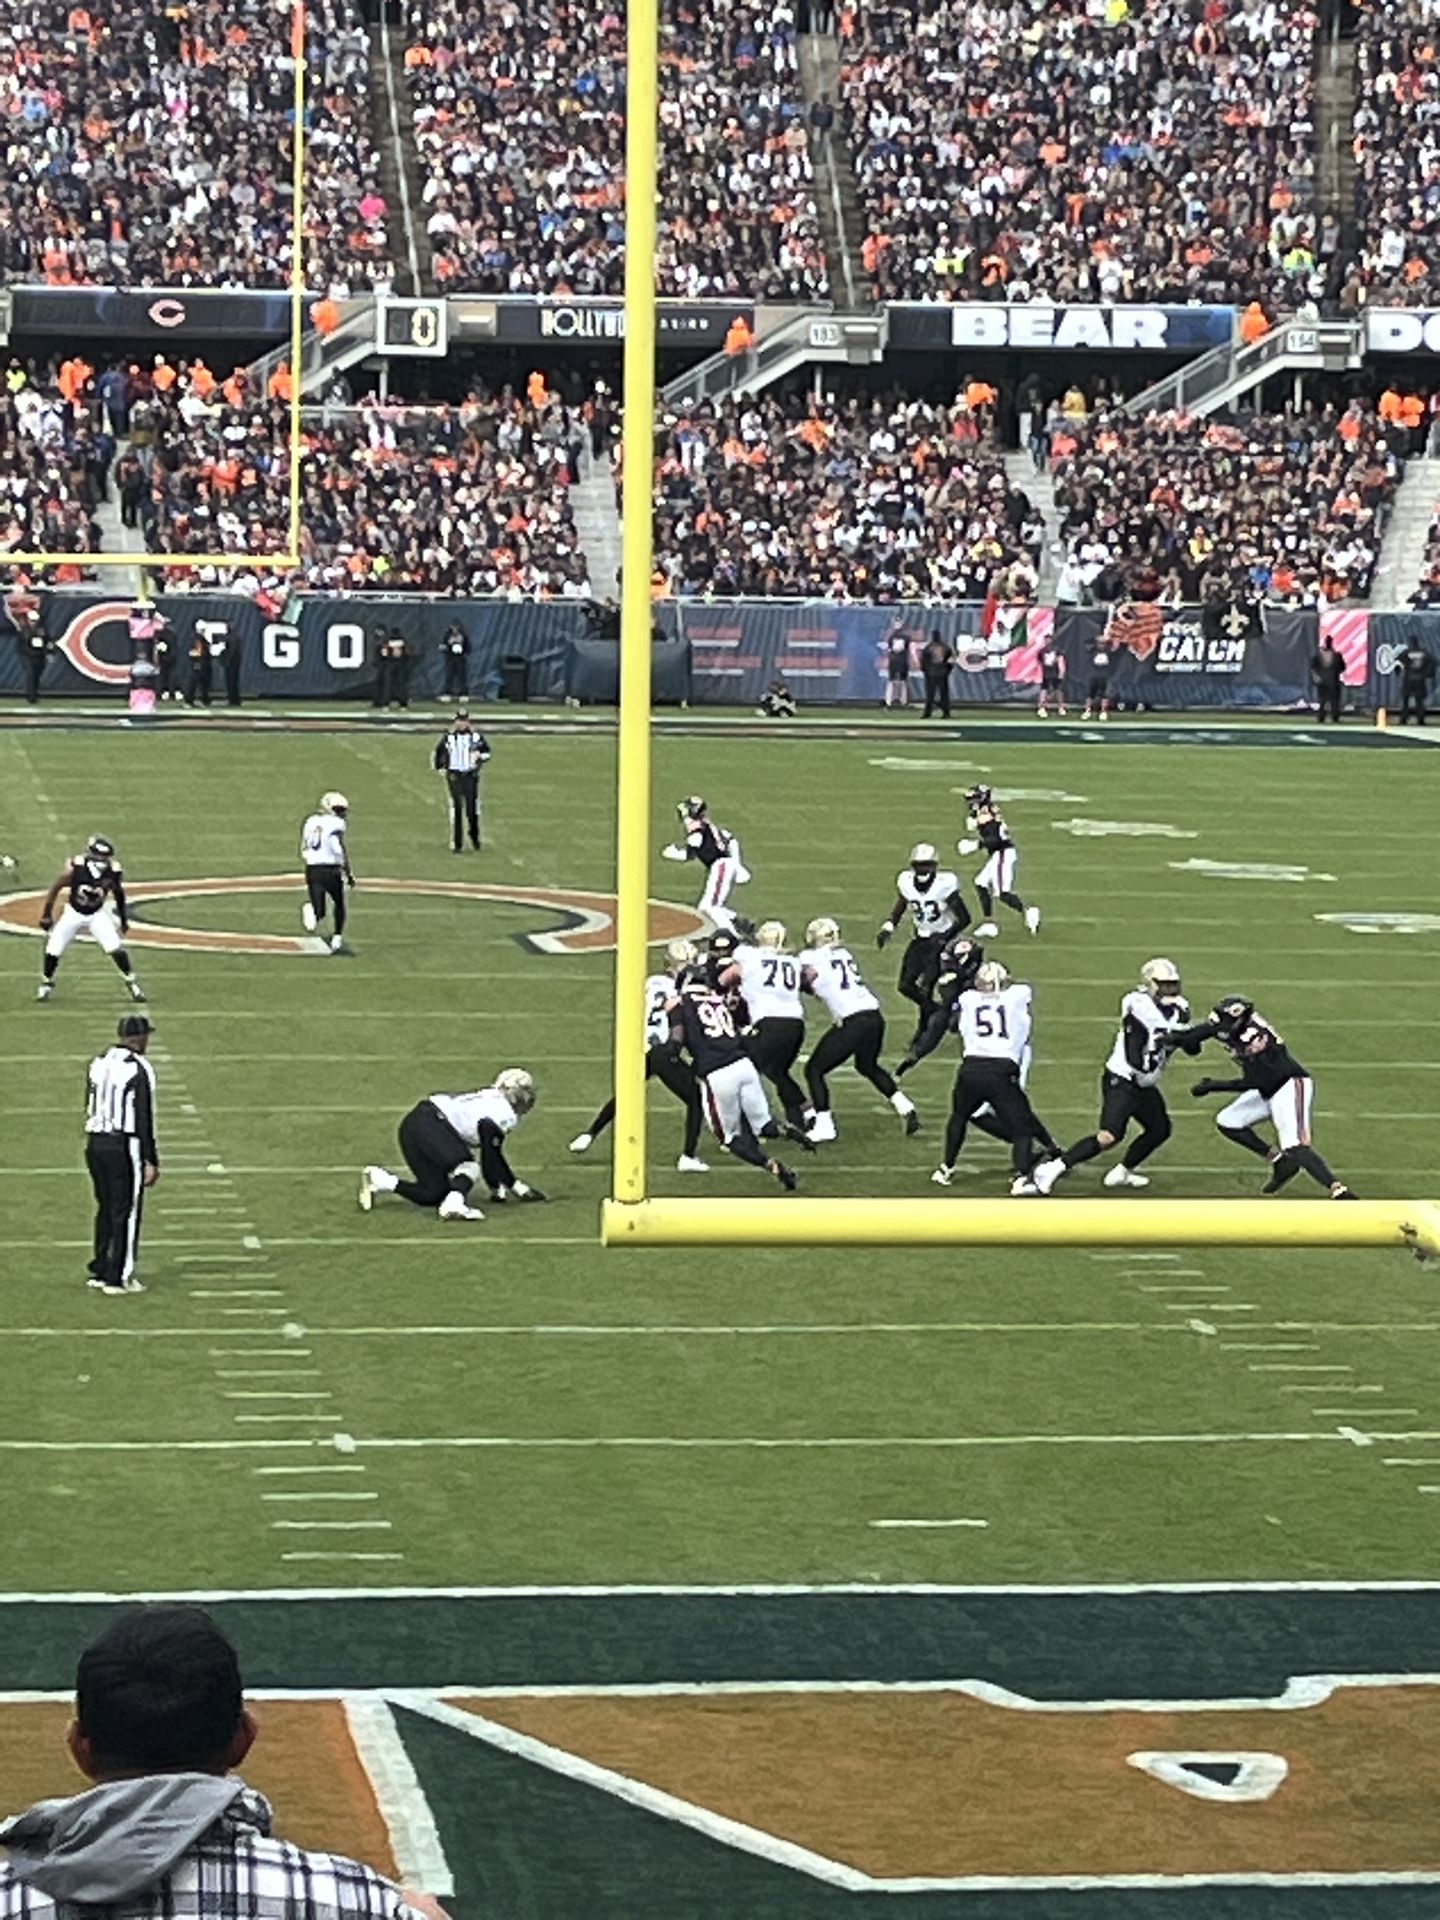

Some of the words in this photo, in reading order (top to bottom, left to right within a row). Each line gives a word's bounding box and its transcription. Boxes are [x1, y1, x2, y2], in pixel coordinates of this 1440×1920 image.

[411, 307, 436, 346] 0
[952, 308, 1169, 348] BEAR
[761, 959, 796, 990] 70
[697, 1001, 736, 1038] 90
[975, 1004, 1010, 1040] 51
